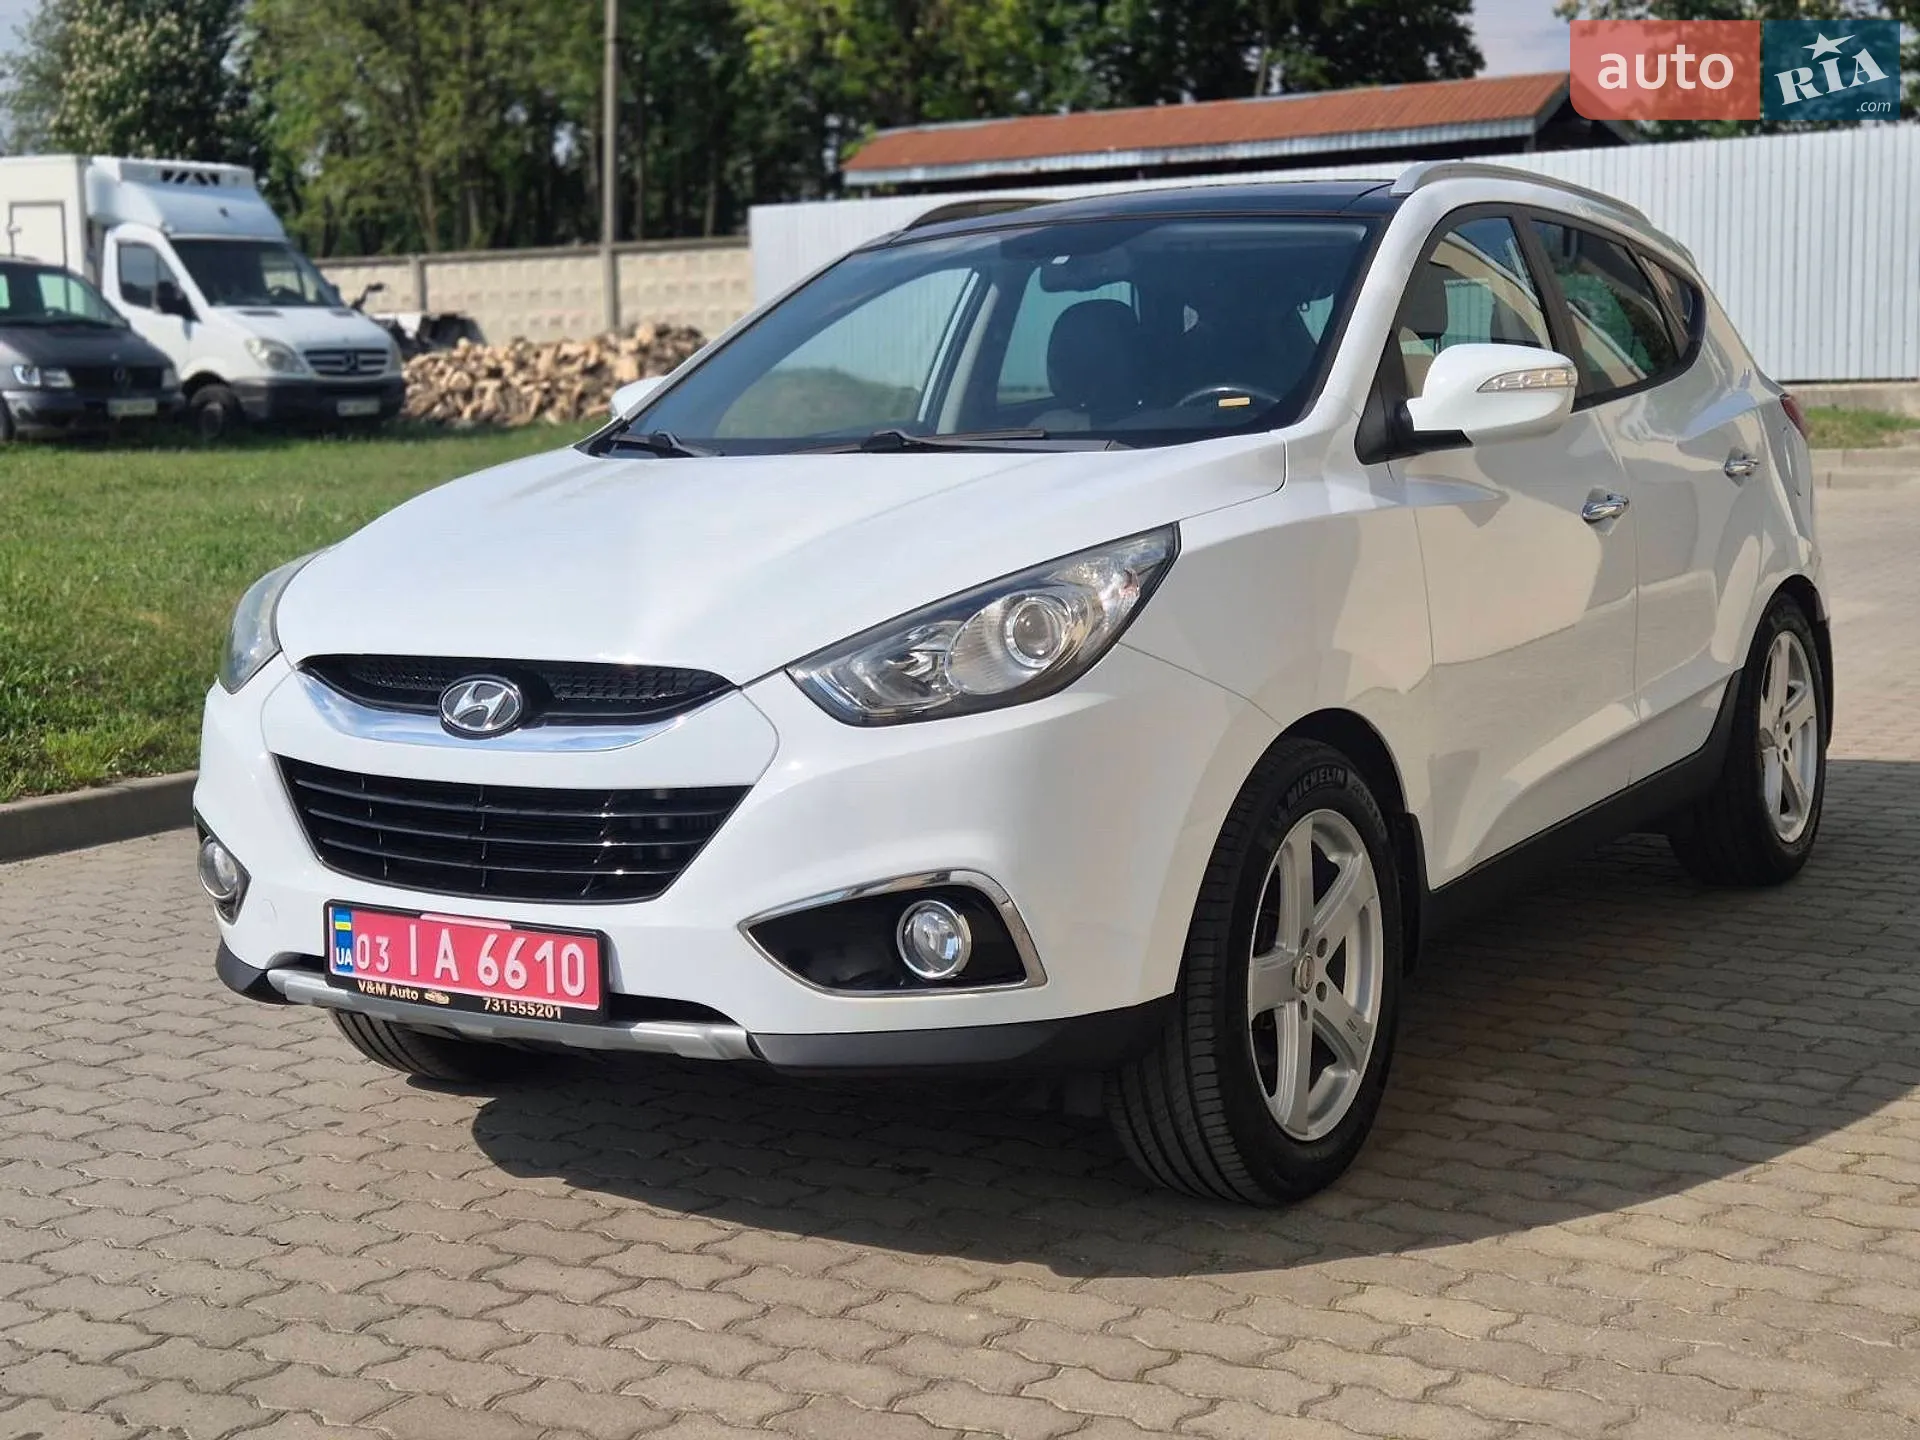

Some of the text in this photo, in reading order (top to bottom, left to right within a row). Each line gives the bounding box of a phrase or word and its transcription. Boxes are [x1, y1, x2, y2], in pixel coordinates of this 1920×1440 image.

[1286, 767, 1346, 809] MICHELIN
[335, 947, 353, 966] UA
[356, 933, 390, 973] 03
[477, 933, 586, 997] 6610
[358, 980, 419, 1001] V&M Auto
[483, 998, 562, 1020] 731555201
